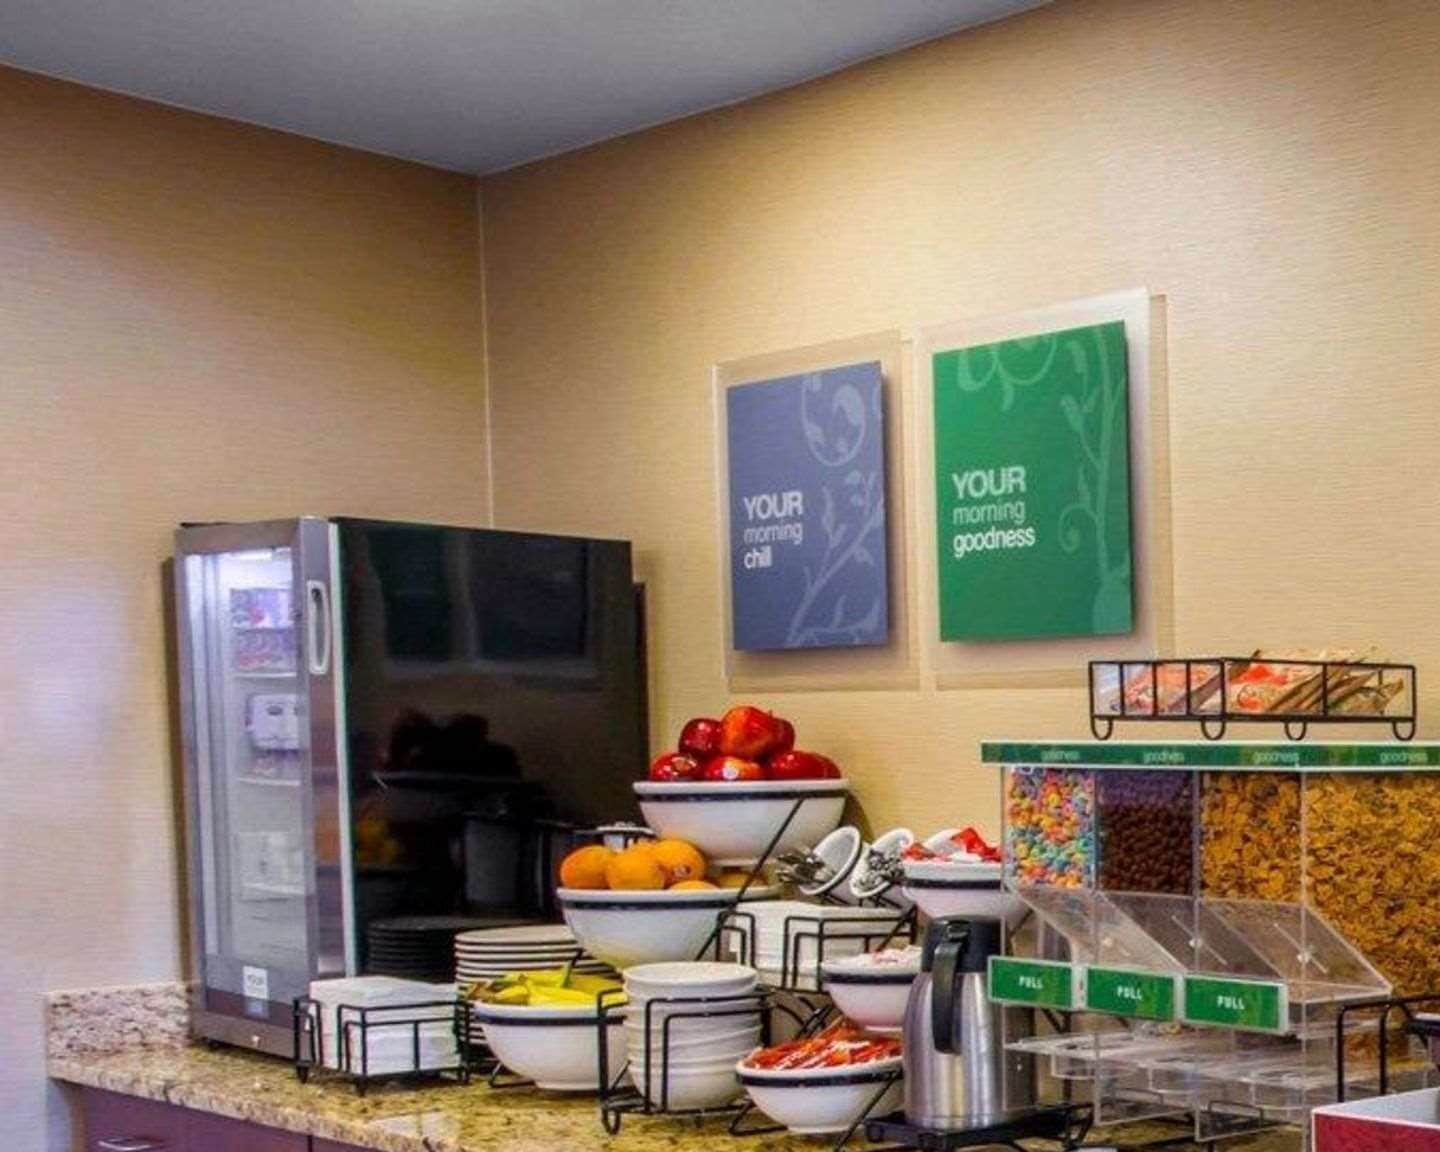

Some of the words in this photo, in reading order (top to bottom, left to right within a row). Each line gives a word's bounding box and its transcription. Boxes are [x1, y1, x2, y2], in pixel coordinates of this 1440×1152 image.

[952, 466, 1027, 499] YOUR
[743, 490, 803, 520] YOUR
[953, 499, 1026, 525] morning
[743, 522, 803, 545] morning
[953, 526, 1036, 559] goodness
[743, 545, 772, 570] chill
[1019, 975, 1044, 989] PULL
[1117, 985, 1143, 1000] PULL
[1217, 995, 1245, 1010] PULL
